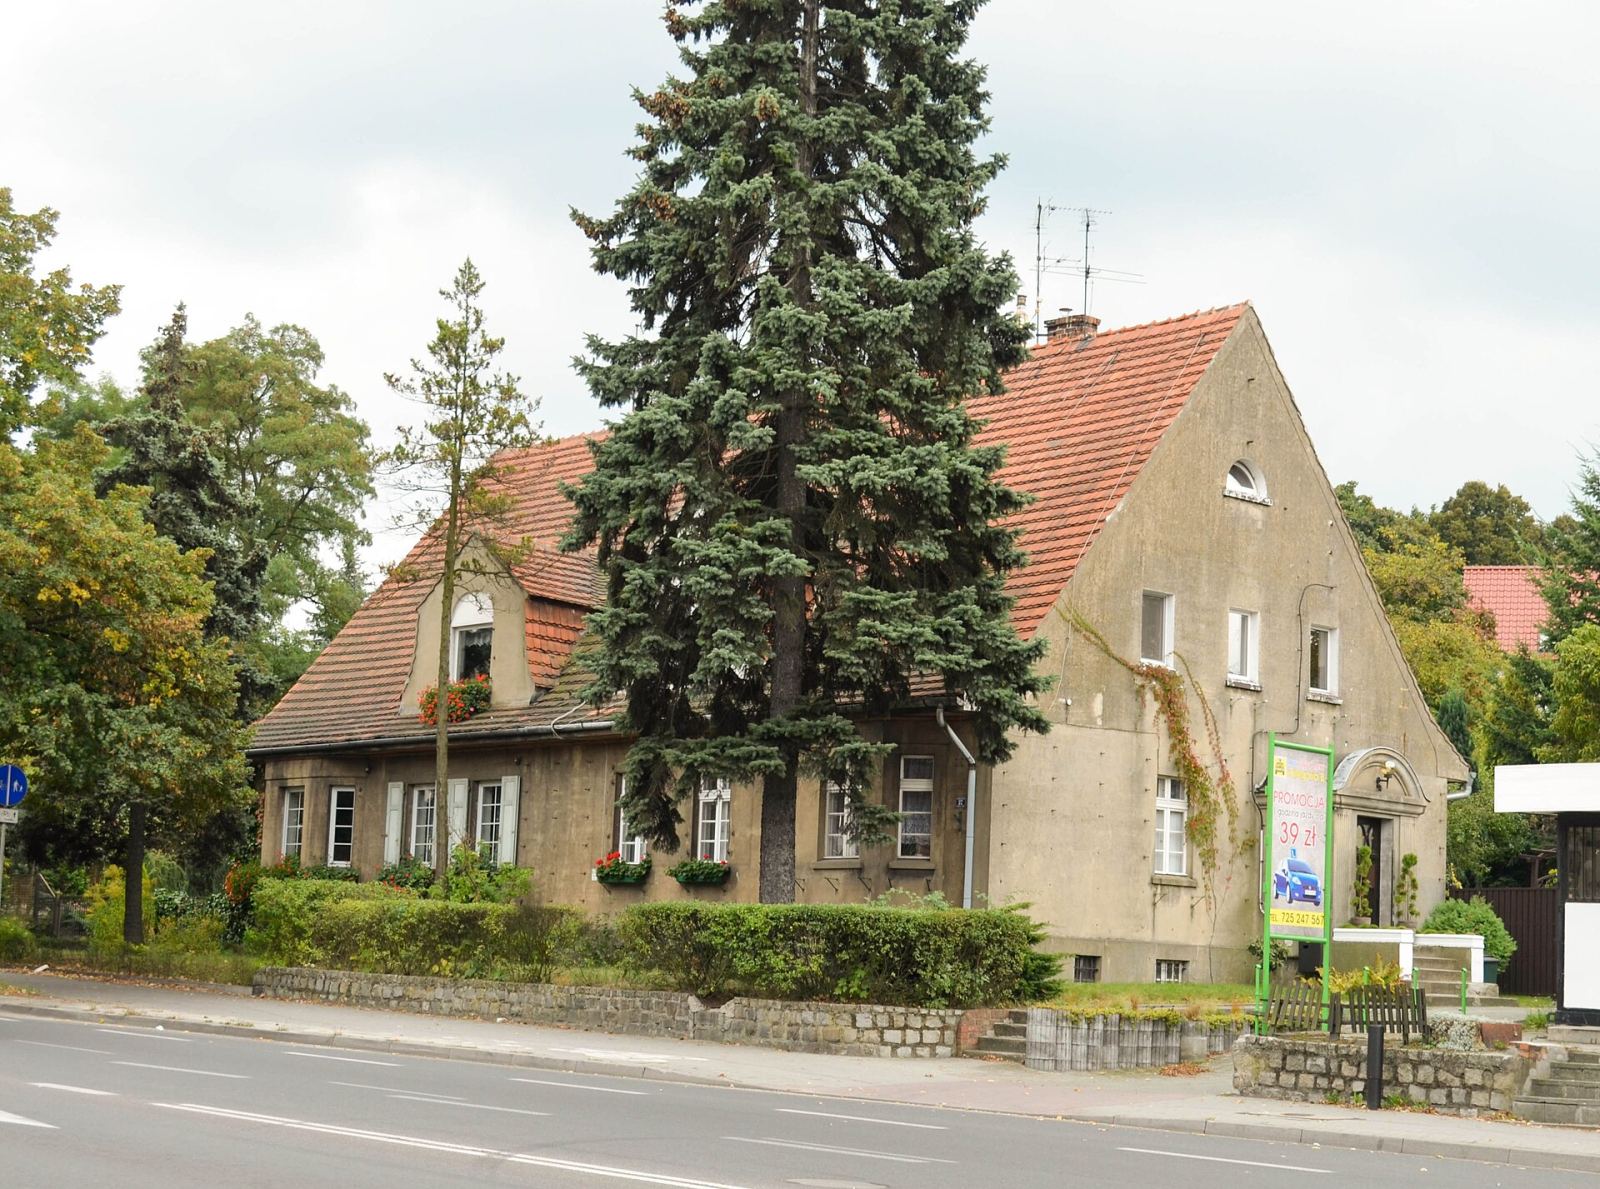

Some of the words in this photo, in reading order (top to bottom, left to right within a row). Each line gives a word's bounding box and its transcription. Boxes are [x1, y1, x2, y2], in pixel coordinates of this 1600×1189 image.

[1274, 790, 1324, 809] PROMOCJA
[1280, 821, 1299, 844] 39
[1304, 825, 1316, 847] zł
[1281, 912, 1295, 923] 725
[1296, 913, 1310, 924] 247
[1311, 914, 1325, 925] 567
